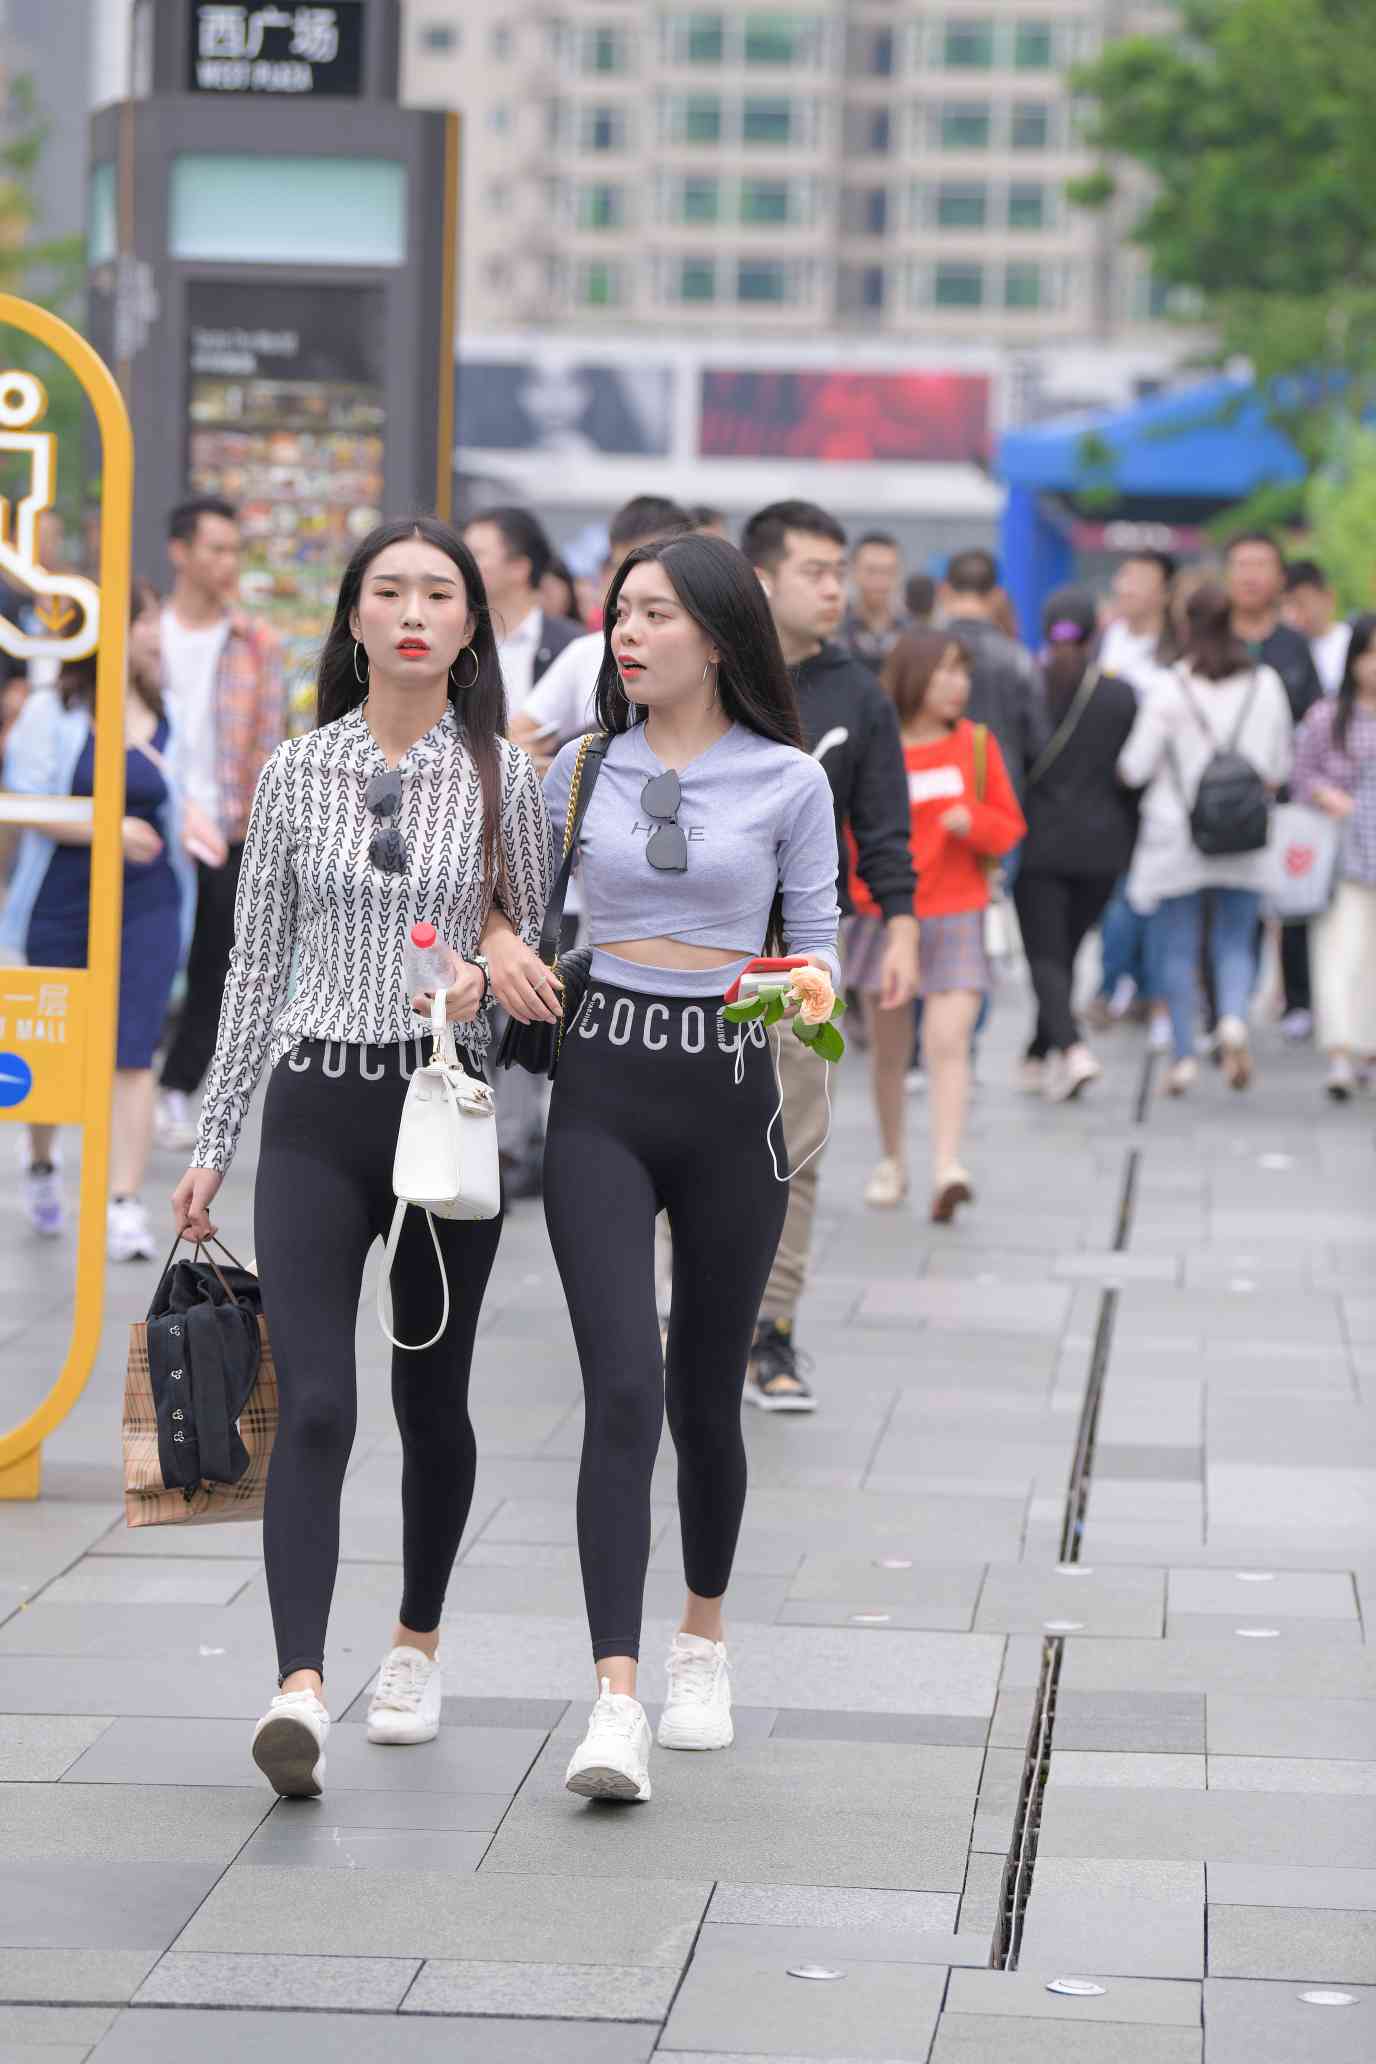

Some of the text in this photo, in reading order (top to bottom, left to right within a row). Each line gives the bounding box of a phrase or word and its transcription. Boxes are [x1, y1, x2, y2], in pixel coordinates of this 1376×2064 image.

[198, 5, 339, 63] 西广场
[15, 1017, 66, 1042] MALL
